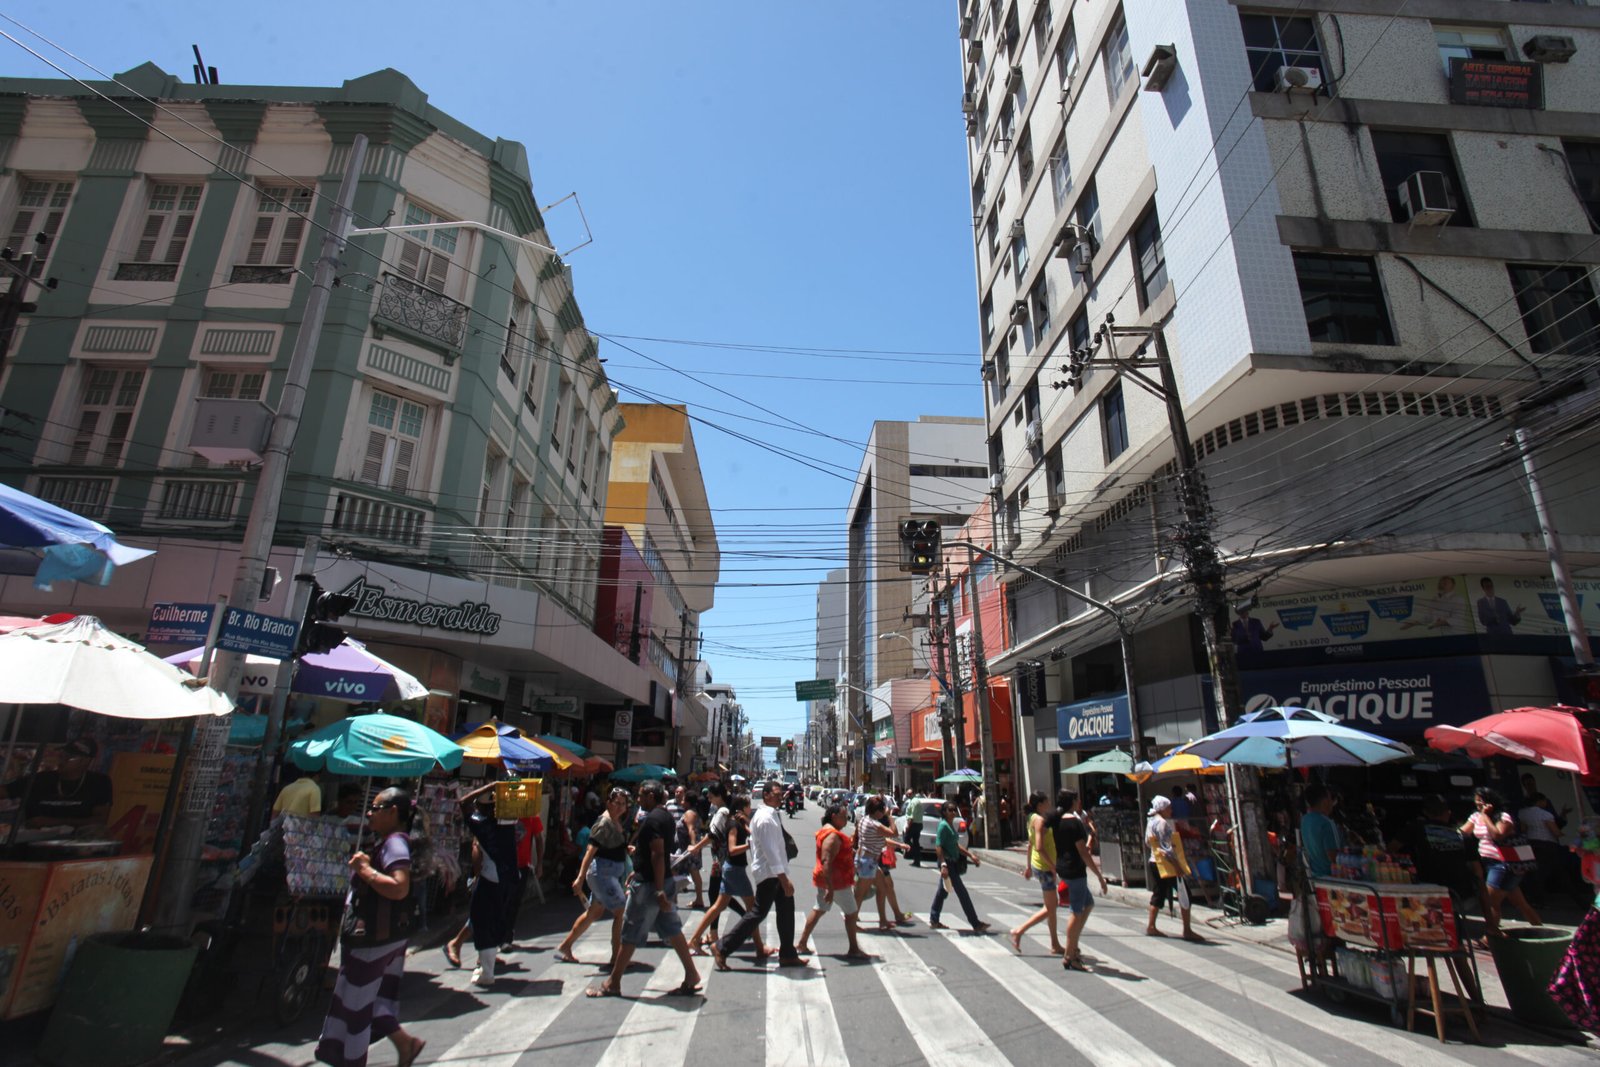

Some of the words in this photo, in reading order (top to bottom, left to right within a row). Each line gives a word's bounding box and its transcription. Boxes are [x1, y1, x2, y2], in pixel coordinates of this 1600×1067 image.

[1513, 580, 1522, 588] O
[1300, 596, 1317, 605] QUE
[1318, 591, 1341, 602] VOCÊ
[152, 605, 208, 623] Guilherme
[349, 586, 502, 633] Esmeralda
[228, 611, 241, 626] Br.
[244, 614, 260, 630] Rio
[261, 618, 295, 637] Branco
[1332, 645, 1363, 653] CACIQUE
[241, 675, 268, 687] ivo
[325, 677, 366, 695] vivo
[1301, 679, 1376, 695] Empréstimo
[1377, 674, 1431, 690] Pessoal
[1077, 714, 1114, 738] CACIQUE
[47, 870, 108, 919] Batatas
